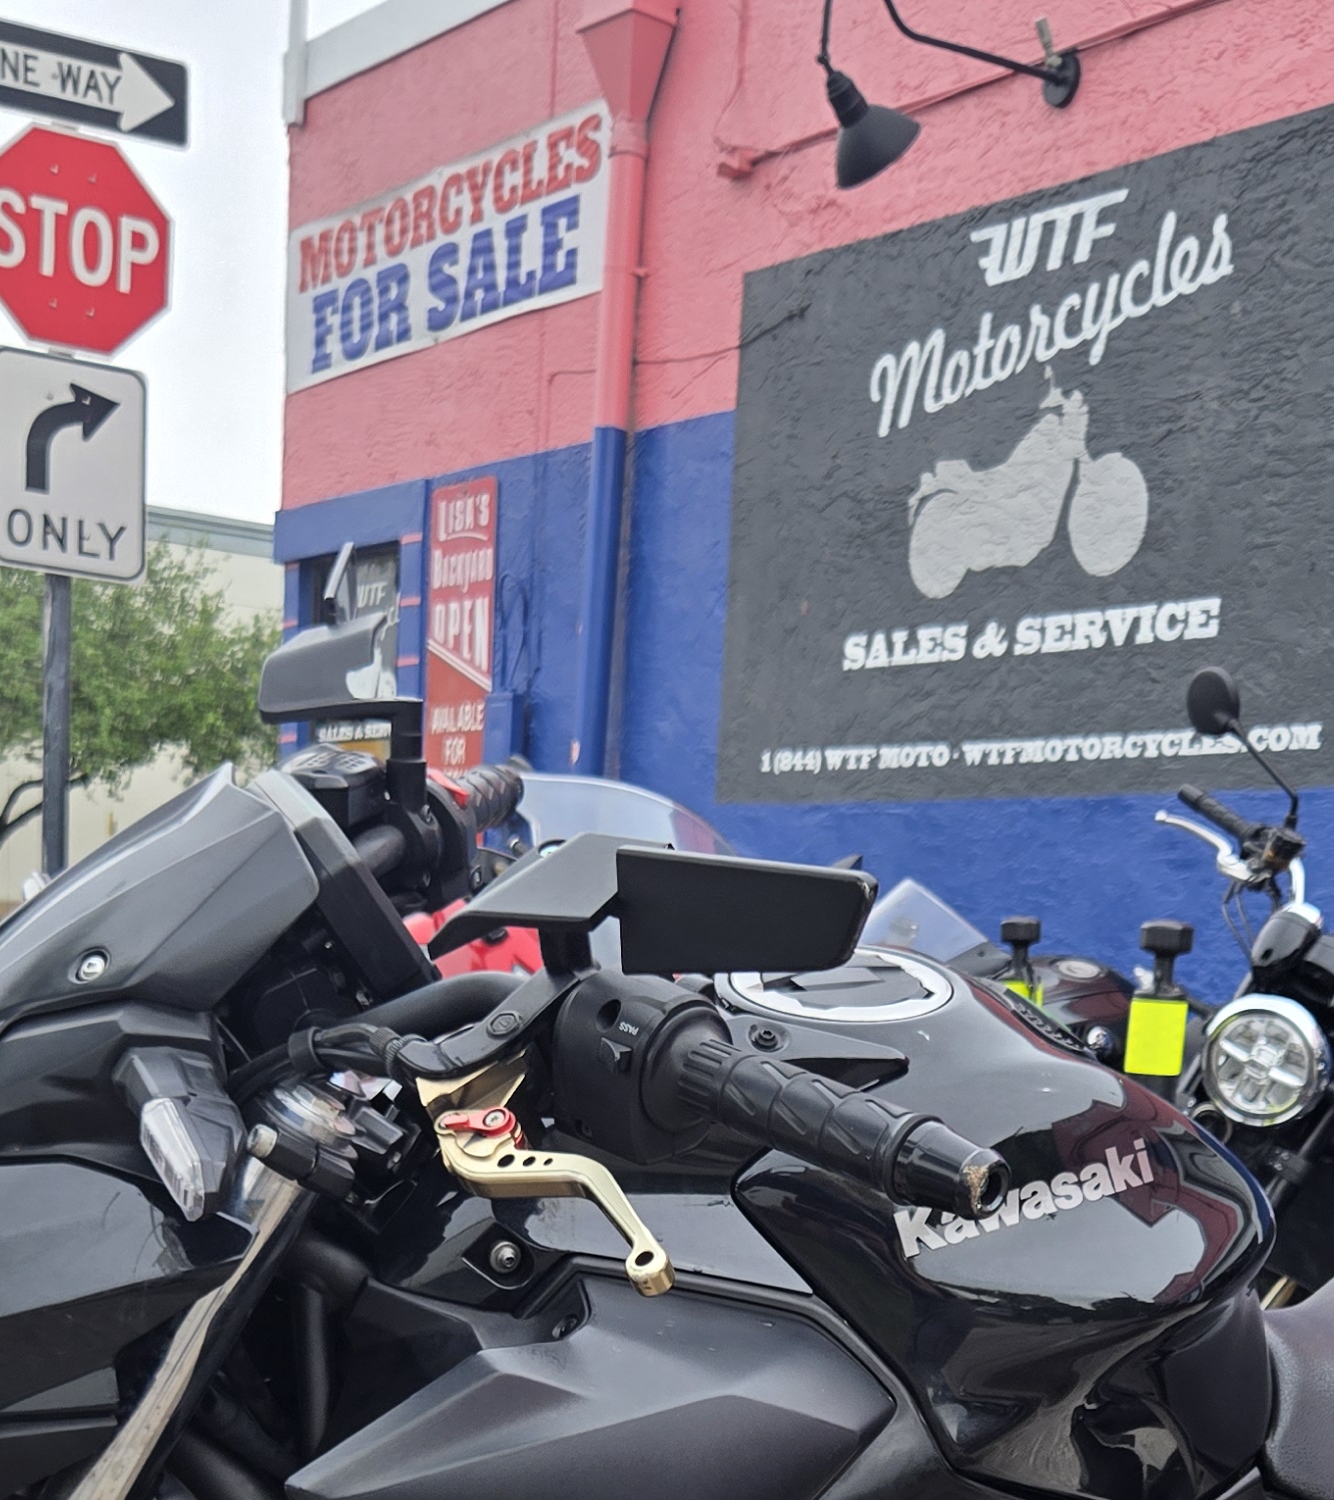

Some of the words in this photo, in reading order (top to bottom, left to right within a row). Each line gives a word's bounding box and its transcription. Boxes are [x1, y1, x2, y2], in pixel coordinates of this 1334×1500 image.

[56, 60, 122, 106] WAY
[298, 112, 603, 295] MOTORCYCLES
[969, 187, 1130, 288] WTF
[310, 261, 413, 375] FOR
[425, 193, 582, 333] SALE
[870, 210, 1235, 438] Motorcycles
[6, 507, 128, 562] ONLY
[437, 492, 491, 542] LISA'S
[432, 596, 489, 672] OPEN
[842, 623, 969, 672] SALES
[970, 619, 1009, 660] &
[1012, 597, 1222, 656] SERVICE
[431, 701, 486, 736] AVAILABLE
[823, 744, 877, 771] WTF
[878, 742, 951, 770] MOTO
[962, 721, 1323, 767] WTFMOTORCYCLES.COM
[444, 737, 466, 766] FOR
[618, 1021, 640, 1037] PASS
[893, 1137, 1154, 1258] Kawasaki
